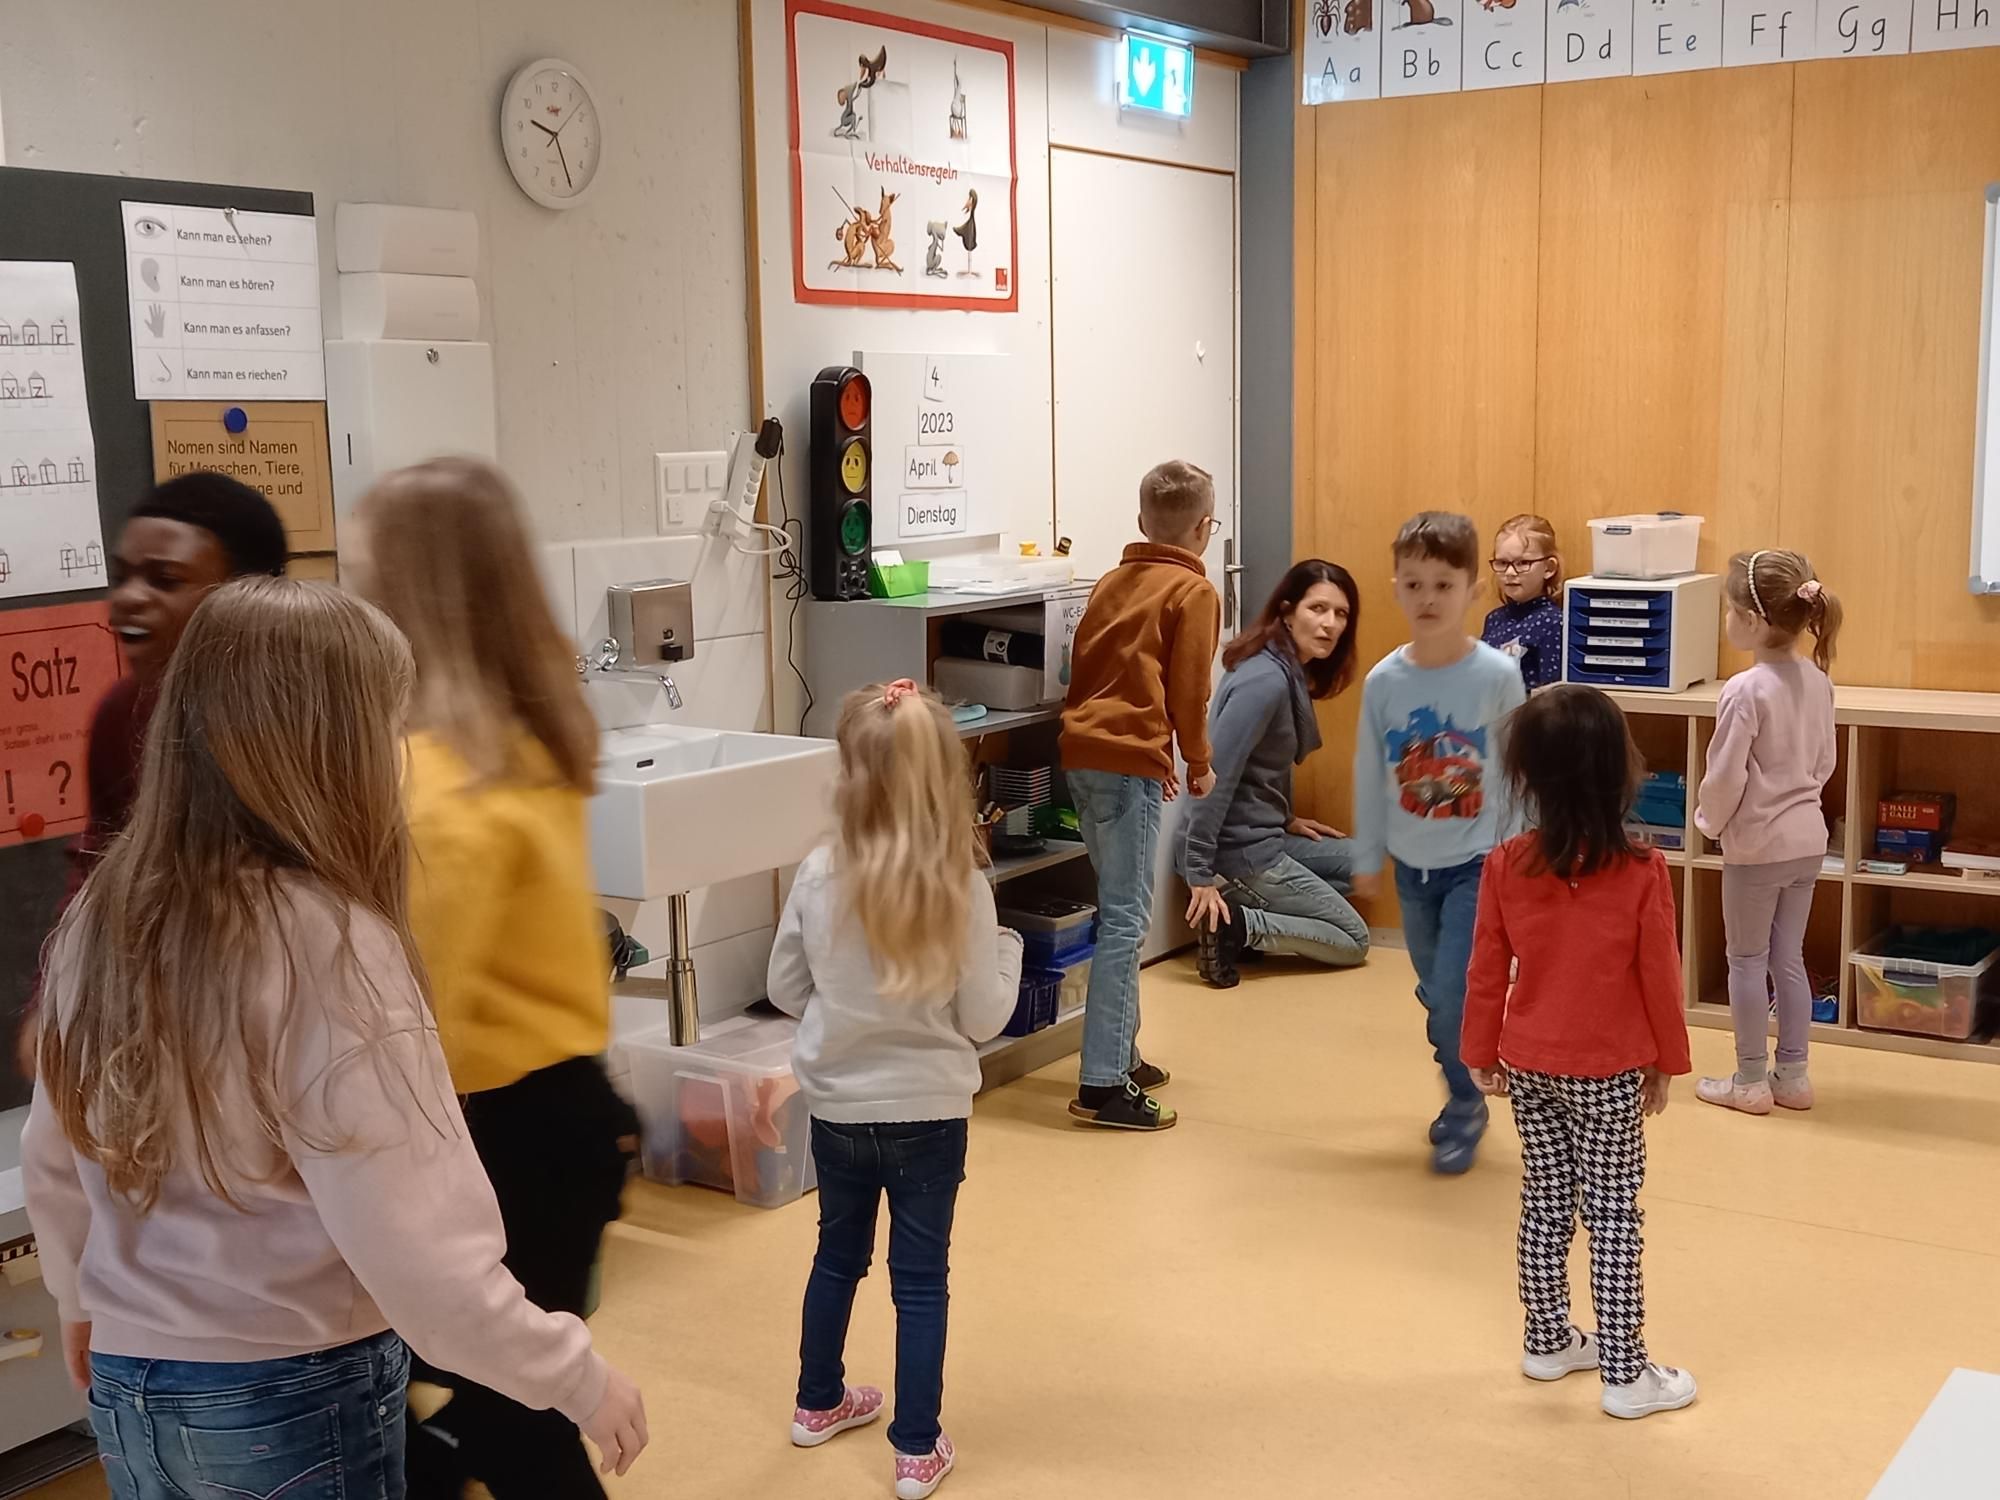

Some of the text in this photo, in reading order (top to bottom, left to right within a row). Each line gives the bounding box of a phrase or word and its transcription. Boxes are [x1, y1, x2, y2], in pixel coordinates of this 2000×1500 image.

[1838, 6, 1886, 53] G g
[1937, 0, 1989, 31] H h
[1566, 28, 1611, 63] D d
[1658, 24, 1697, 55] E e
[1750, 11, 1792, 58] F f
[1403, 48, 1440, 79] B b
[1484, 40, 1523, 70] C c
[1321, 57, 1361, 86] A a
[865, 152, 958, 185] Verhaltensregeln
[177, 229, 272, 246] Kann man es sehen?
[180, 275, 274, 291] Kann man es hören?
[184, 322, 290, 336] Kann man es anfassen?
[187, 368, 287, 381] Kann man es riechen?
[921, 412, 954, 434] 2023
[167, 440, 298, 454] Nomen sind Namen
[169, 461, 185, 475] für
[265, 460, 303, 476] Tiere,
[909, 458, 937, 480] April
[278, 481, 303, 495] und
[907, 505, 957, 526] Dienstag
[11, 647, 80, 702] Satz
[48, 760, 72, 805] ?
